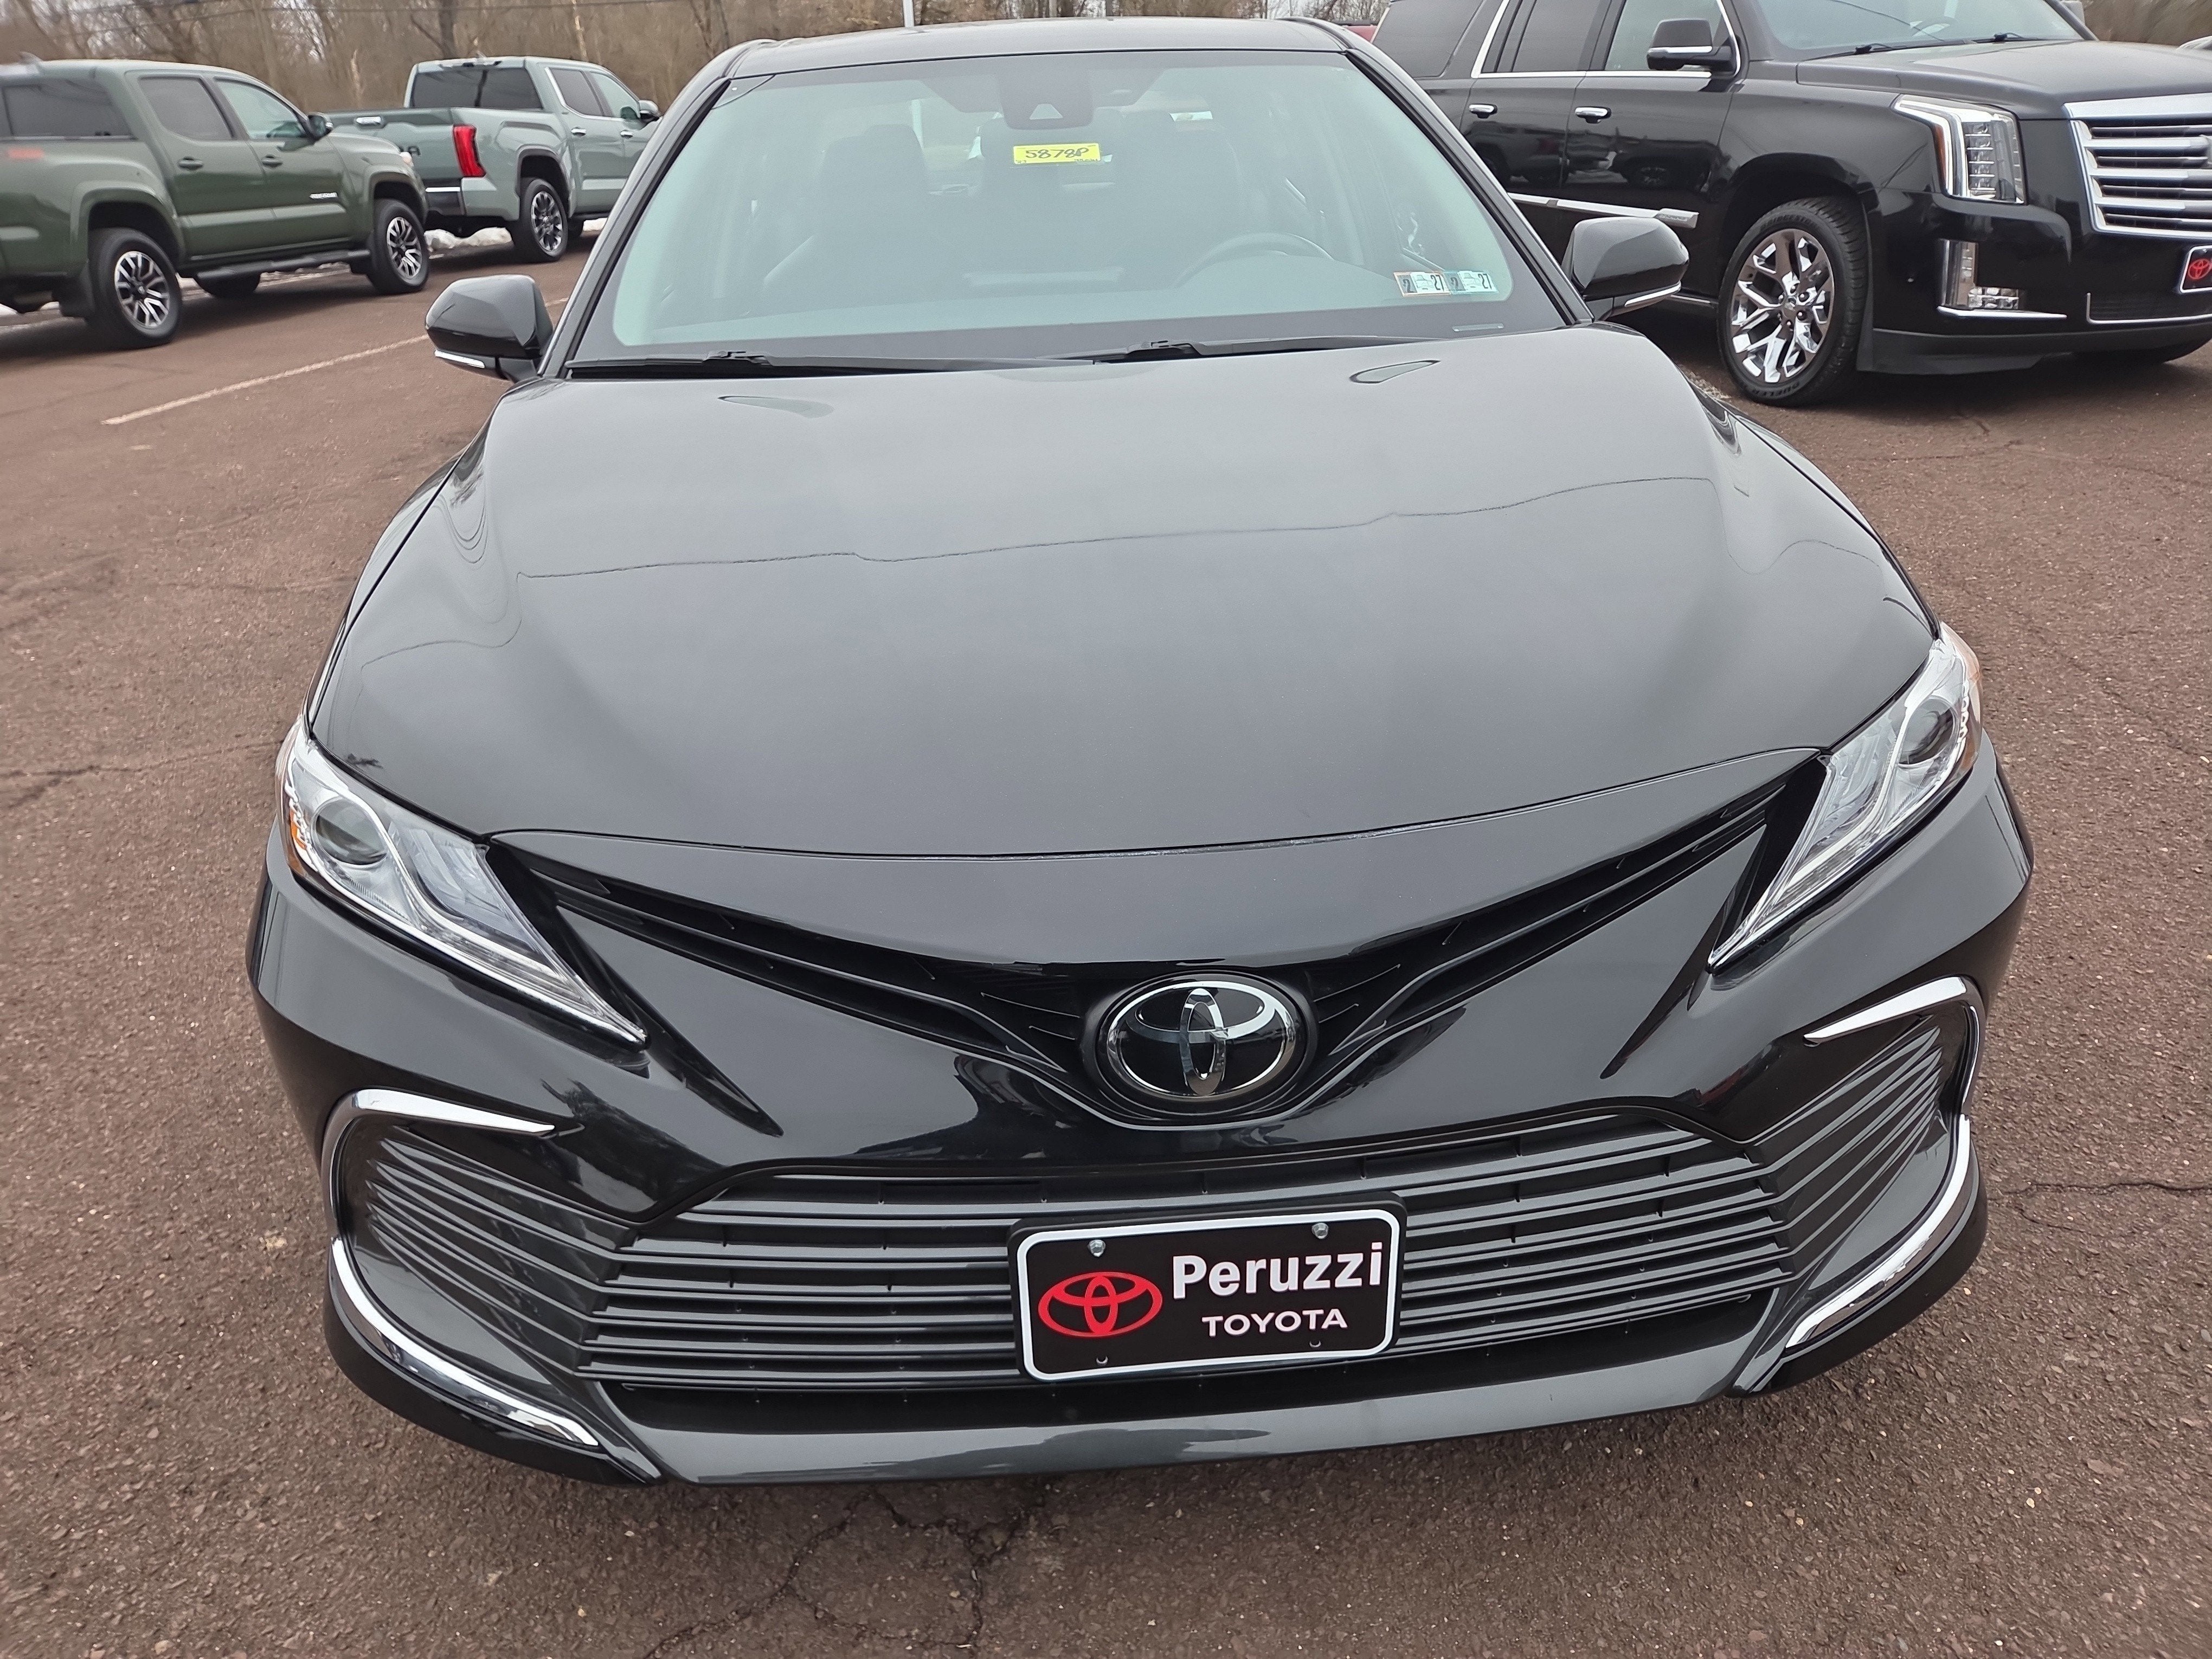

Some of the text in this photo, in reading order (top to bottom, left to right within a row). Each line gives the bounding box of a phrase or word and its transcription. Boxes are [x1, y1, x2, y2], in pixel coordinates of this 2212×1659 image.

[1430, 274, 1444, 291] 27
[1478, 273, 1491, 290] 27
[1173, 1242, 1382, 1299] Peruzzi
[1201, 1308, 1348, 1336] TOYOTA
